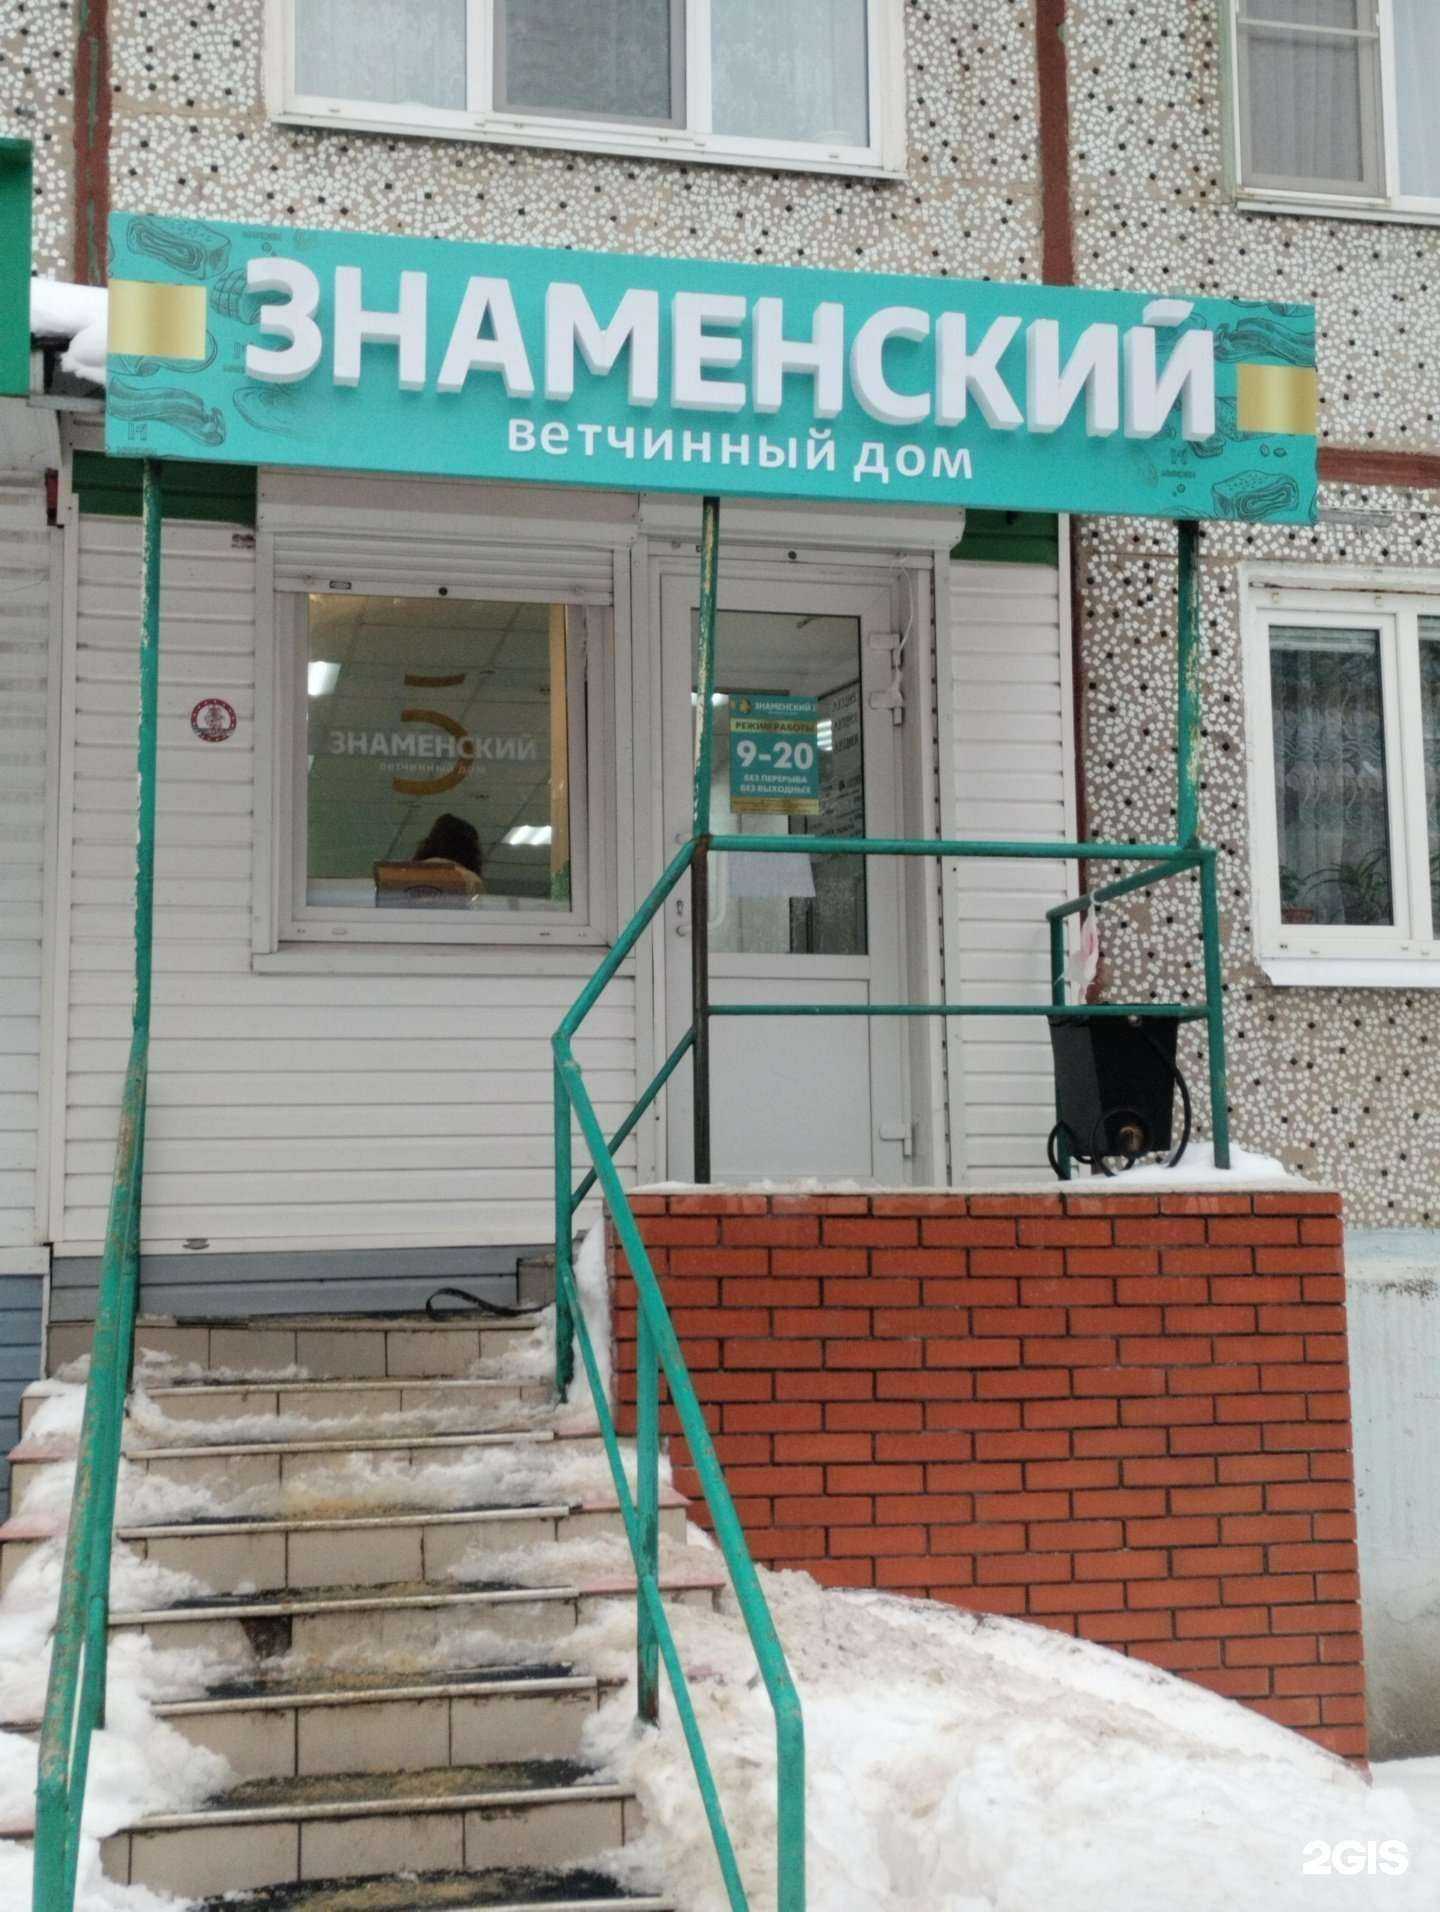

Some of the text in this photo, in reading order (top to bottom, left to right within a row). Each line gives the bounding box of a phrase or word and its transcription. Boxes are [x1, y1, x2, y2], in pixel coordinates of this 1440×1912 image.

[245, 257, 1216, 442] ЗНАМЕНСКИЙ
[507, 417, 974, 485] ветчинный дом
[328, 731, 537, 761] ЗНАМЕНСКИЙ
[736, 740, 814, 770] 9-20
